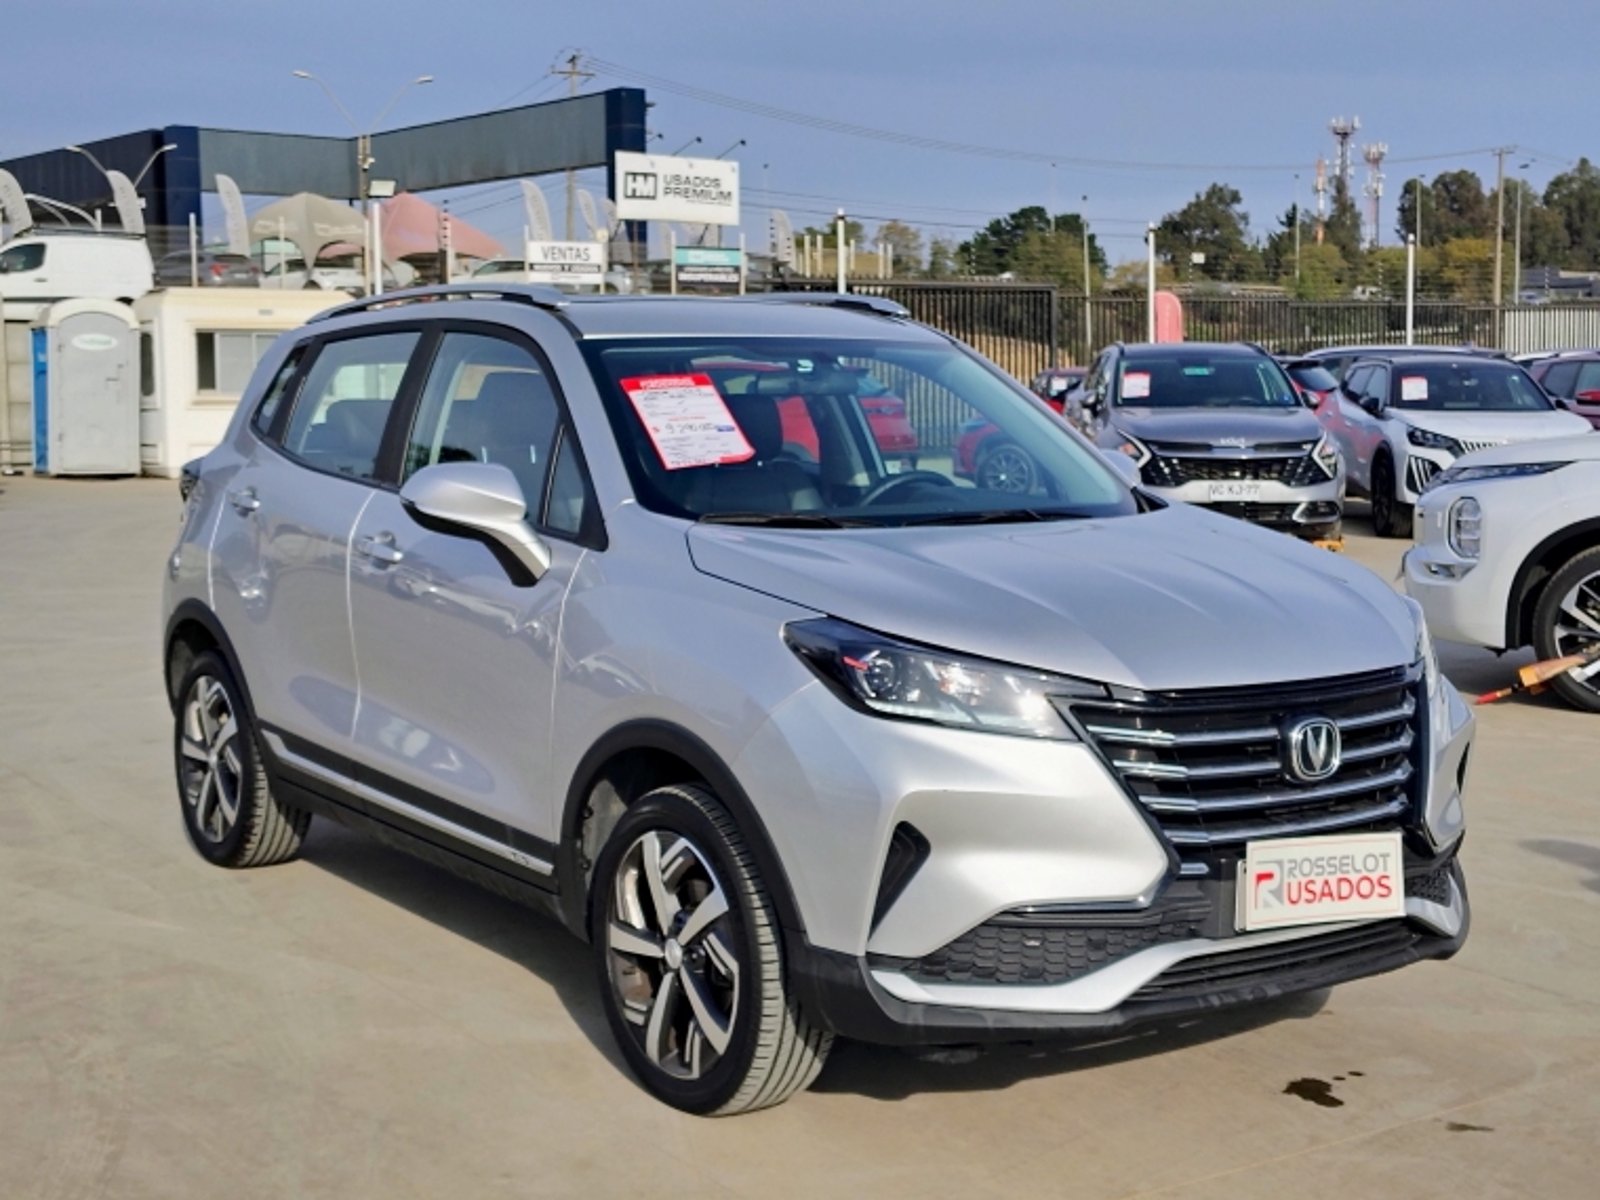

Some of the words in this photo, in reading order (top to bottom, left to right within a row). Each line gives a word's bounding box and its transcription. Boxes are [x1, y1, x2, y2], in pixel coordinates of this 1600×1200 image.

[663, 174, 721, 189] USADOS
[663, 187, 732, 202] PREMIUM
[541, 245, 591, 261] VENTAS
[1287, 852, 1391, 877] ROSSELOT
[1287, 874, 1393, 905] USADOS
